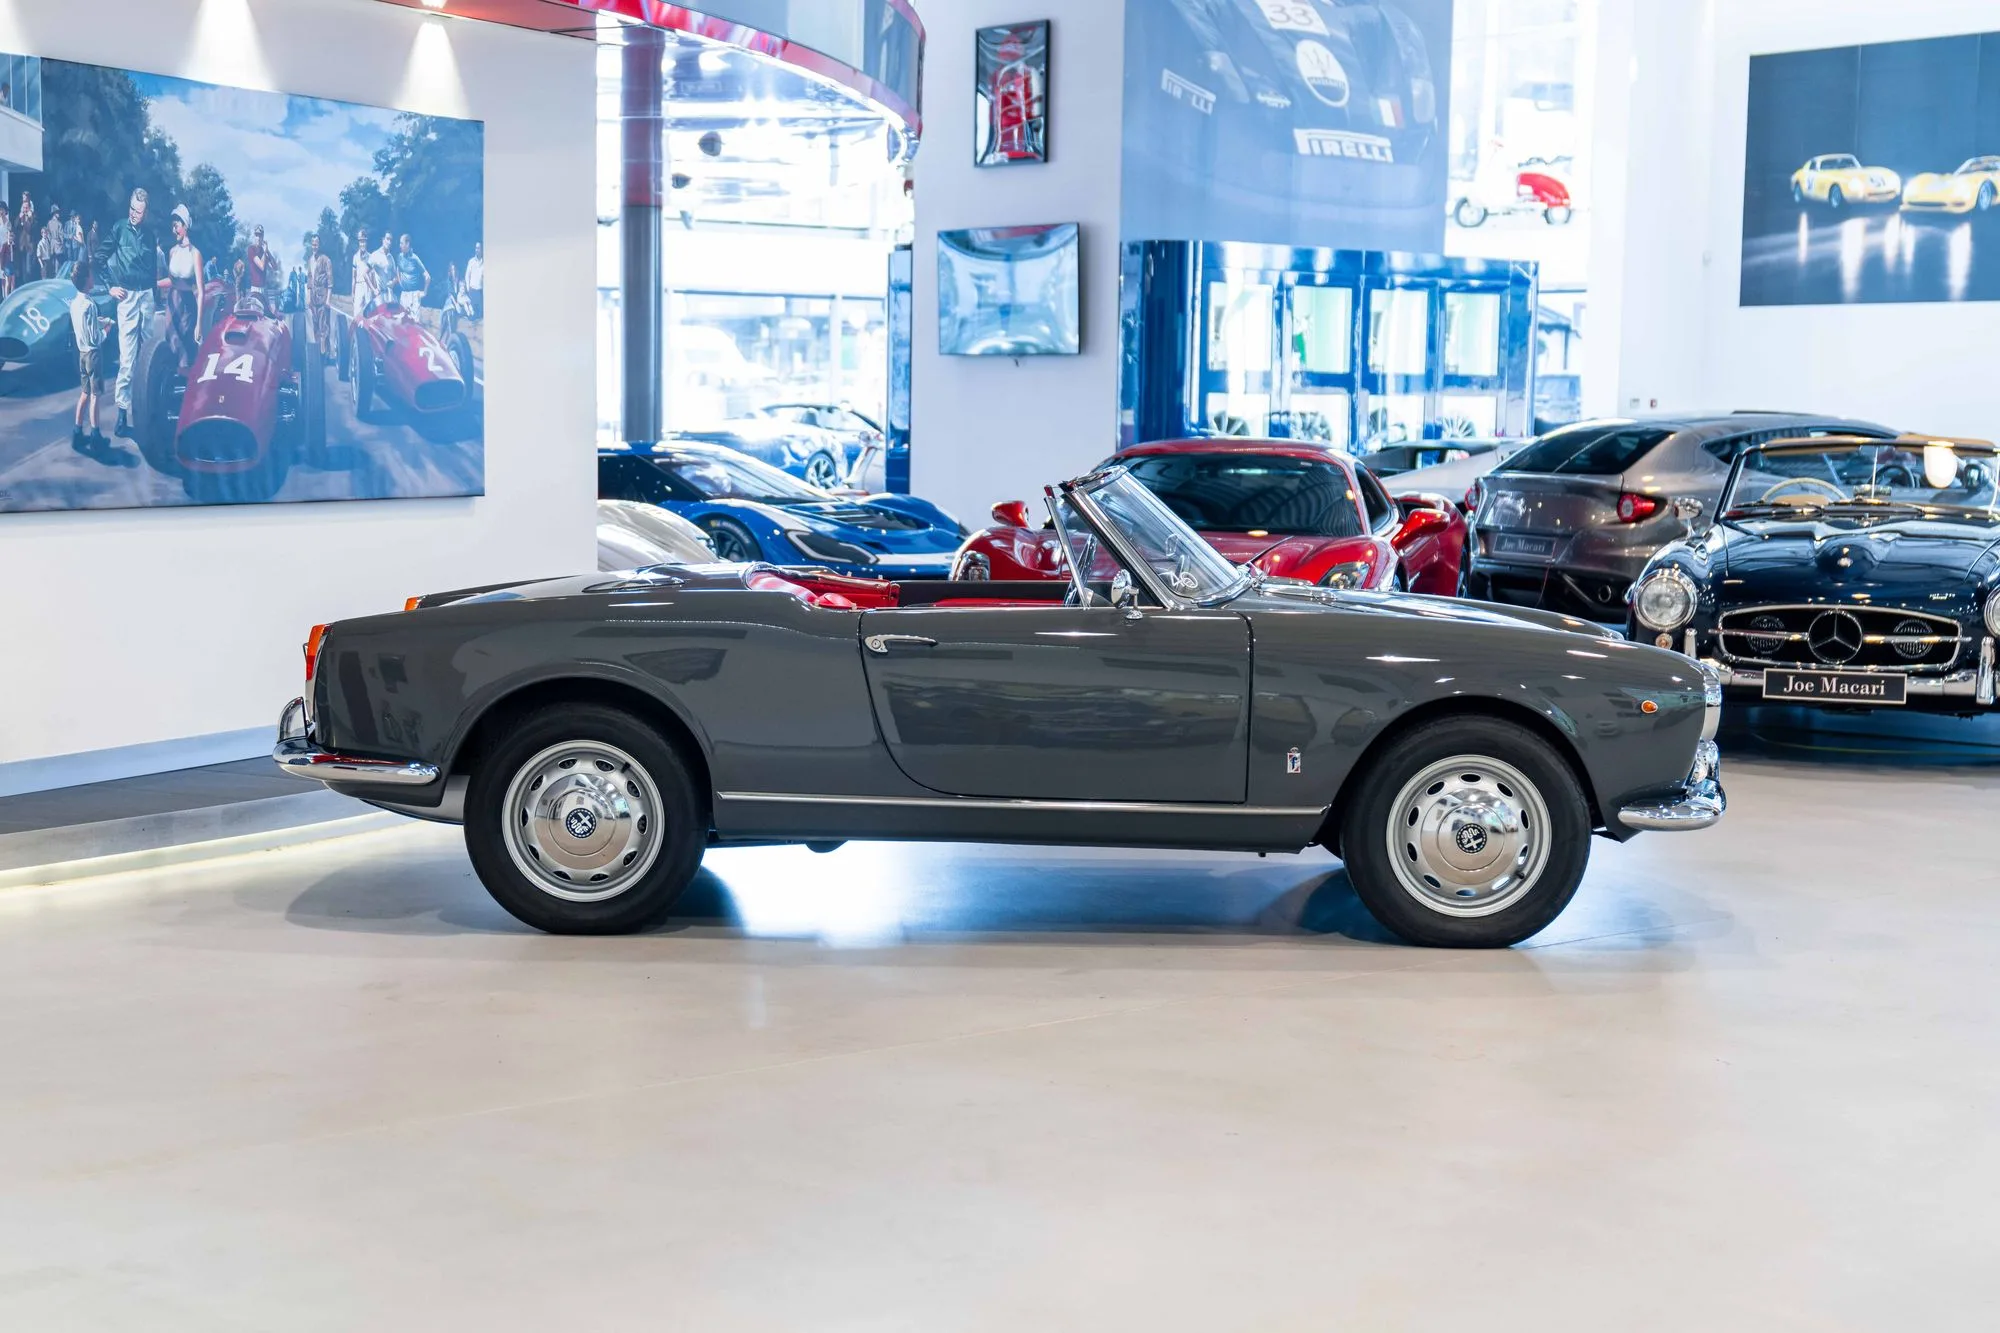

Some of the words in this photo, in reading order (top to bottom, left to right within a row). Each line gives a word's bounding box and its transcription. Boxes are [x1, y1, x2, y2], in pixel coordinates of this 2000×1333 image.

[1268, 4, 1313, 26] 33
[1161, 68, 1216, 115] PIRLLI
[1293, 128, 1393, 163] PIRELLI
[19, 307, 50, 334] 18
[197, 353, 253, 383] 14
[1783, 675, 1815, 693] Joe
[1820, 677, 1886, 696] Macari
